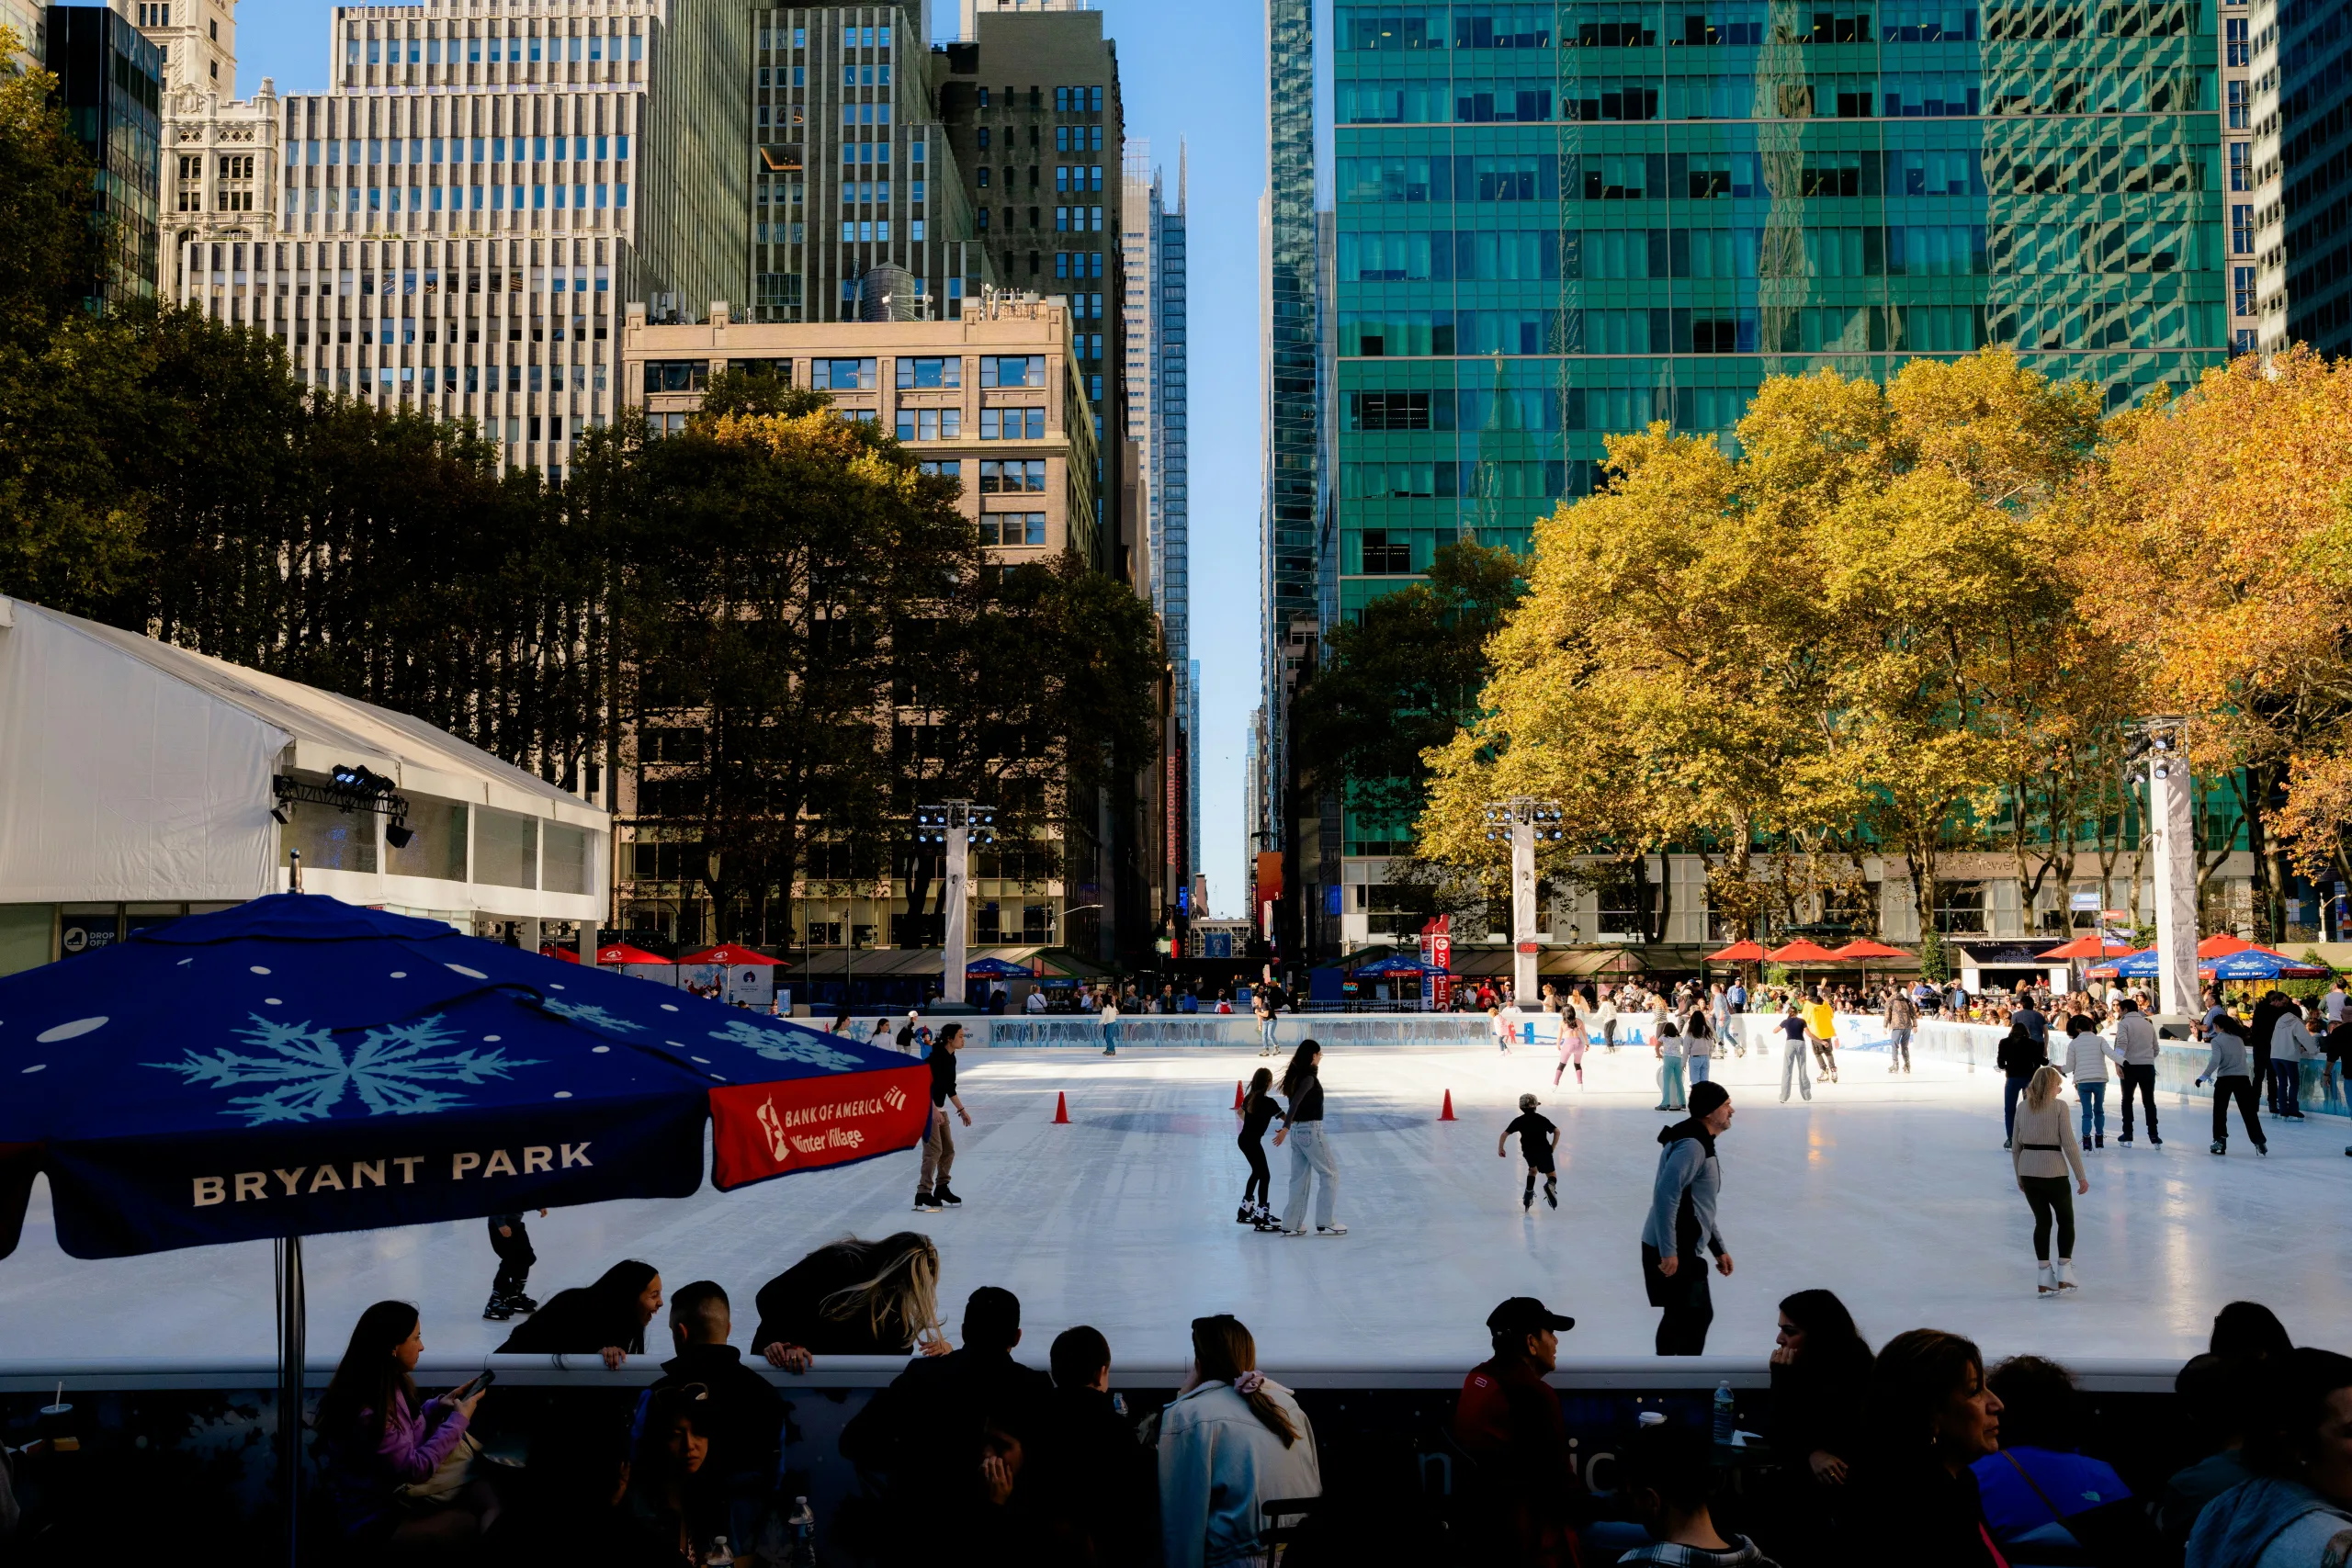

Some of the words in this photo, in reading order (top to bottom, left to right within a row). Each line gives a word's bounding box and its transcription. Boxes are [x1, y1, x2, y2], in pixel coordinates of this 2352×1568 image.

[1167, 756, 1176, 865] ApexForYouth.org
[1978, 859, 2015, 871] Tower
[1993, 952, 2037, 966] chalet
[786, 1107, 818, 1128] BANK
[819, 1103, 833, 1122] OF
[835, 1098, 885, 1119] AMERICA
[790, 1134, 826, 1154] Winter
[827, 1128, 865, 1149] Village
[192, 1156, 424, 1207] BRYANT
[452, 1142, 594, 1179] PARK
